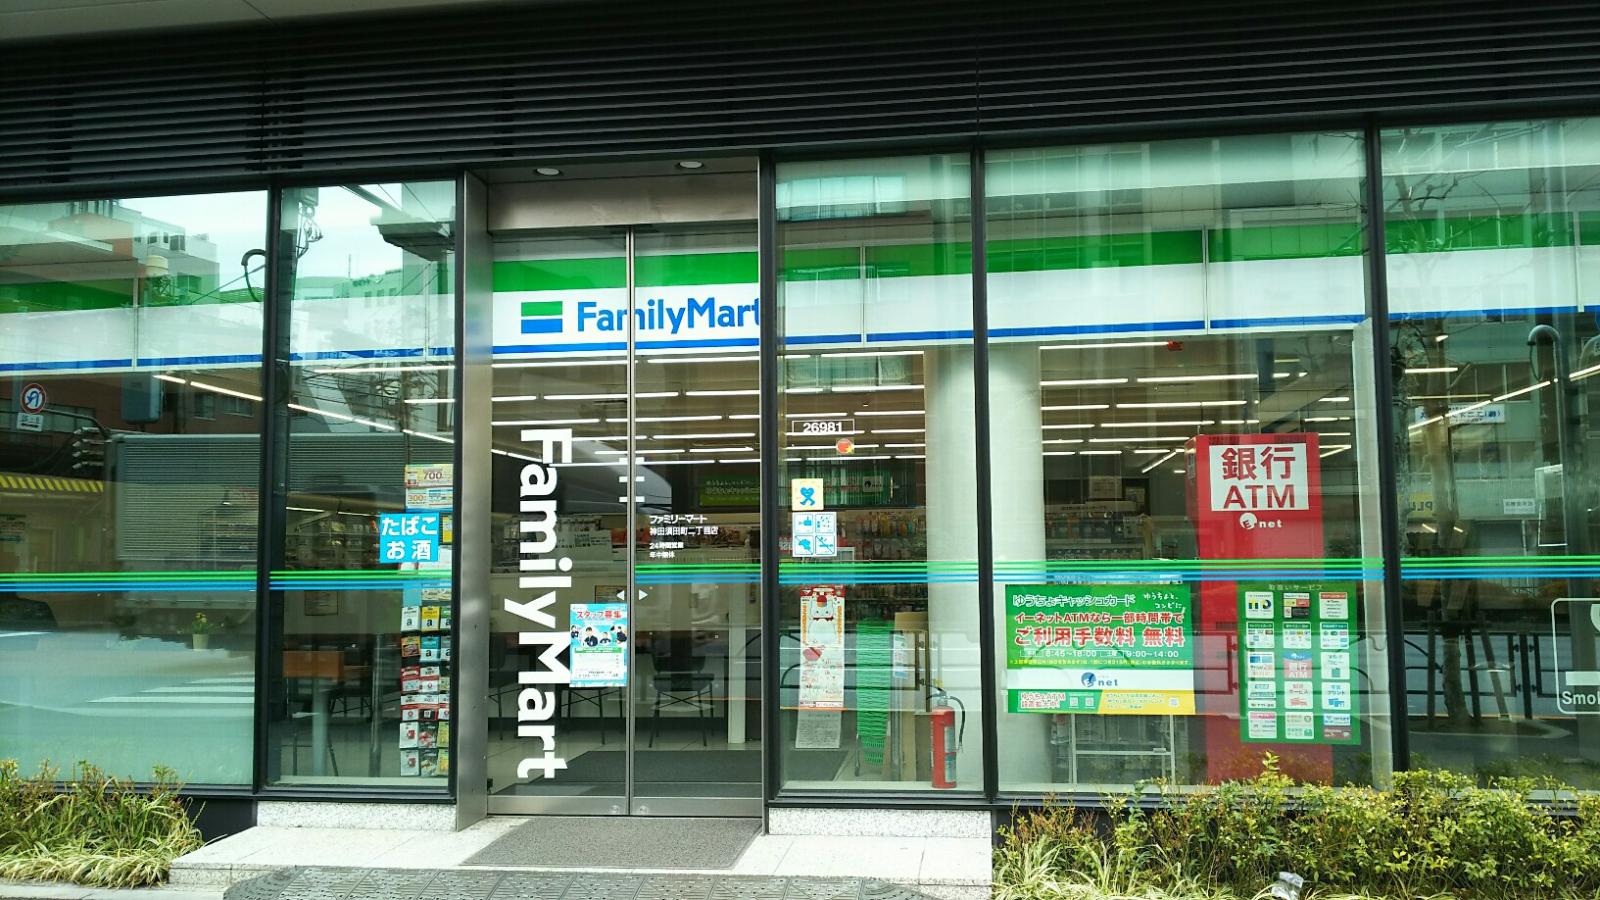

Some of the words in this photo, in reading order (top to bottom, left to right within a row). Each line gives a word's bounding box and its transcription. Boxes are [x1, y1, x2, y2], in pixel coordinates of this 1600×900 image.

[577, 297, 761, 334] FamilyMart
[802, 421, 843, 434] 26981
[1220, 446, 1296, 481] 銀行
[1223, 484, 1296, 509] ATM
[381, 516, 438, 536] たばこ
[649, 514, 708, 525] ファミリーマート
[1259, 519, 1283, 529] net
[386, 539, 432, 561] お酒
[504, 428, 573, 779] FamilyMart
[1012, 593, 1137, 608] ゆうちょキャッシュカード
[576, 610, 622, 620] スタッフ募集
[1015, 611, 1185, 624] イーネットATMなら一部時間帯で
[1015, 626, 1136, 647] ご利用手数料
[1142, 626, 1186, 647] 無料
[1097, 678, 1119, 687] net
